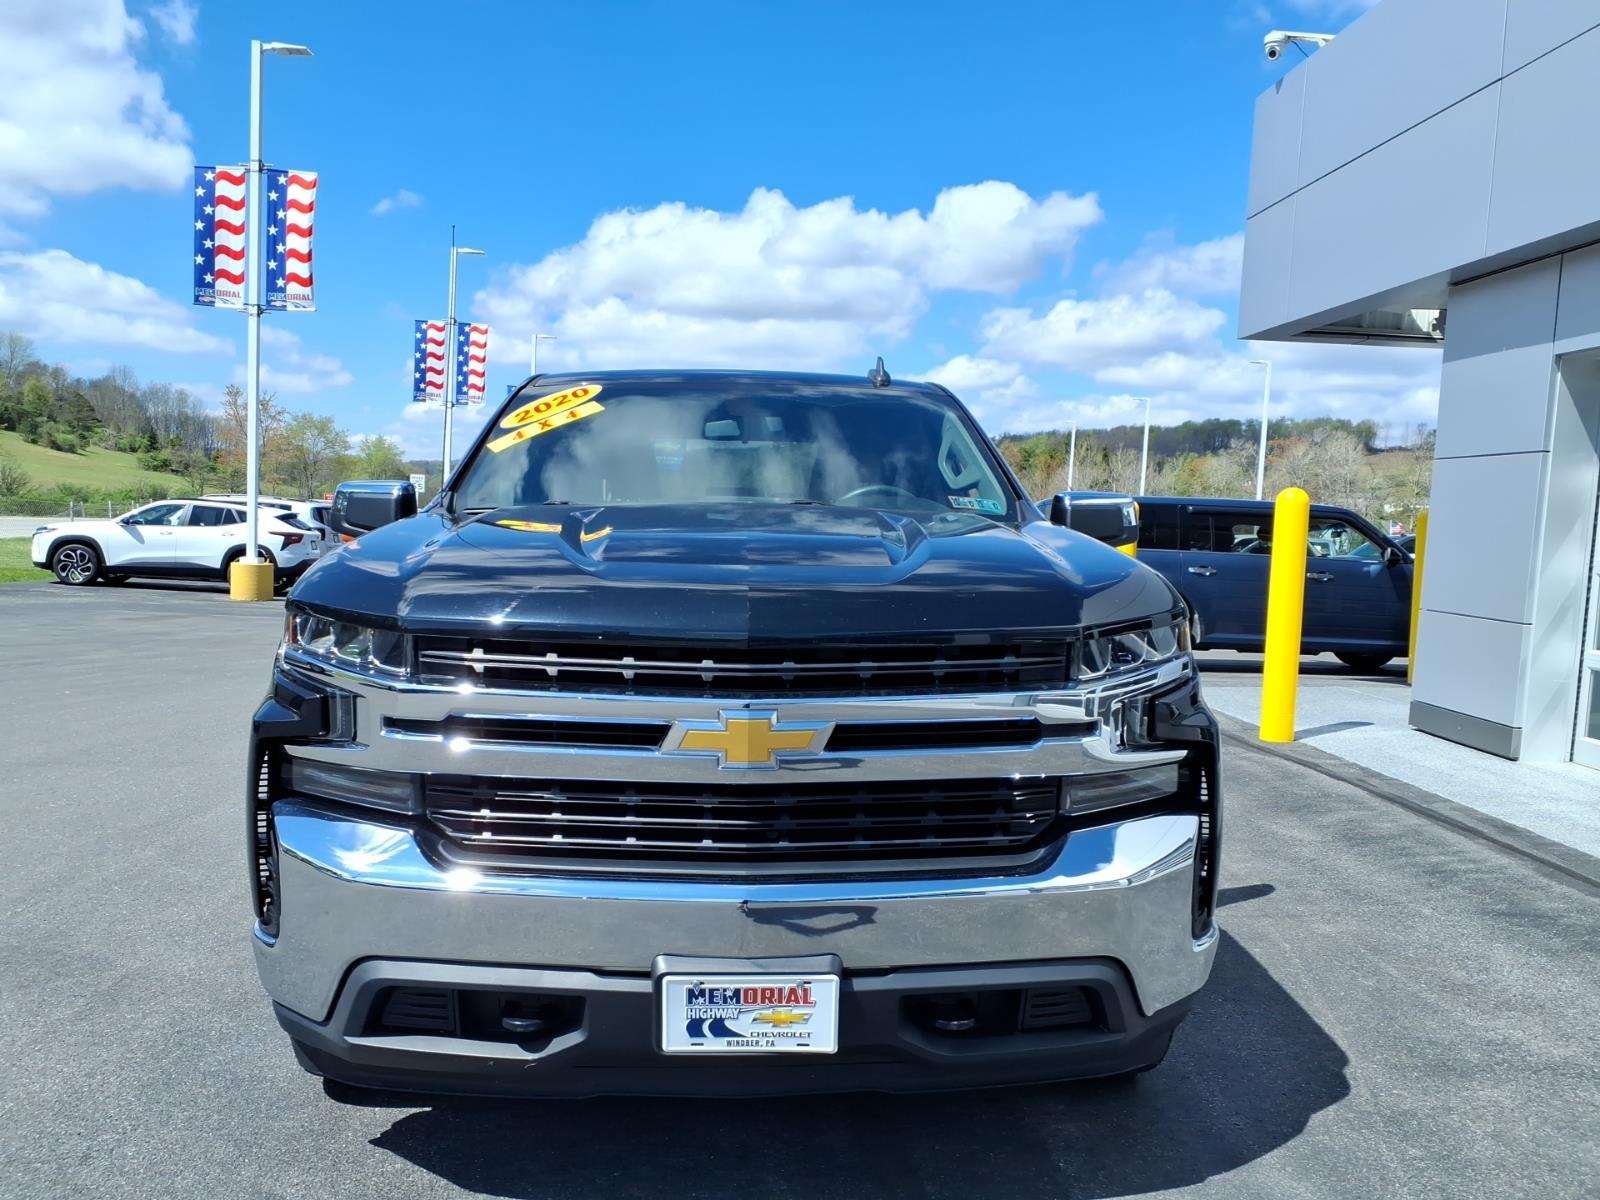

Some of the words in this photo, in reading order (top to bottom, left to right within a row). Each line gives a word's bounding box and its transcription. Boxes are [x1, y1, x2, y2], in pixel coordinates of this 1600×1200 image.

[514, 388, 589, 424] 2020
[687, 986, 815, 1006] MEMORIAL
[687, 1007, 741, 1020] HIGHWAY
[750, 1031, 814, 1039] CHEVROLET
[765, 1039, 776, 1048] PA
